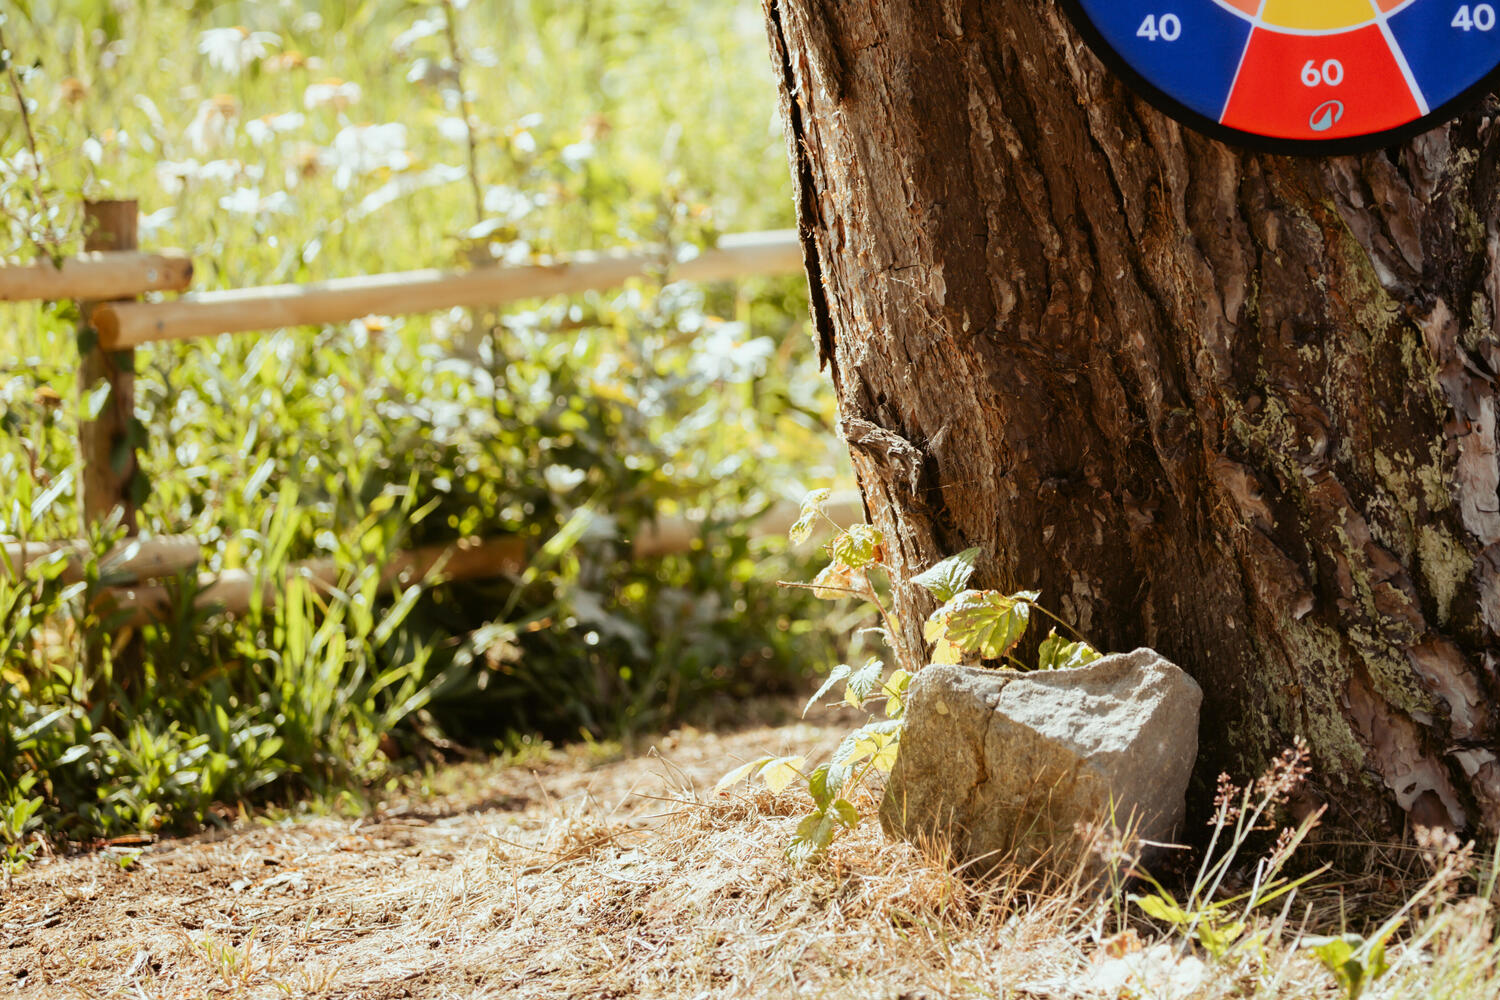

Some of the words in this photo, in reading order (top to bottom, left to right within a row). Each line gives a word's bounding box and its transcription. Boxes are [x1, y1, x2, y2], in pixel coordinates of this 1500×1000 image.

[1137, 13, 1181, 41] 40
[1451, 4, 1495, 31] 40
[1301, 59, 1343, 87] 60
